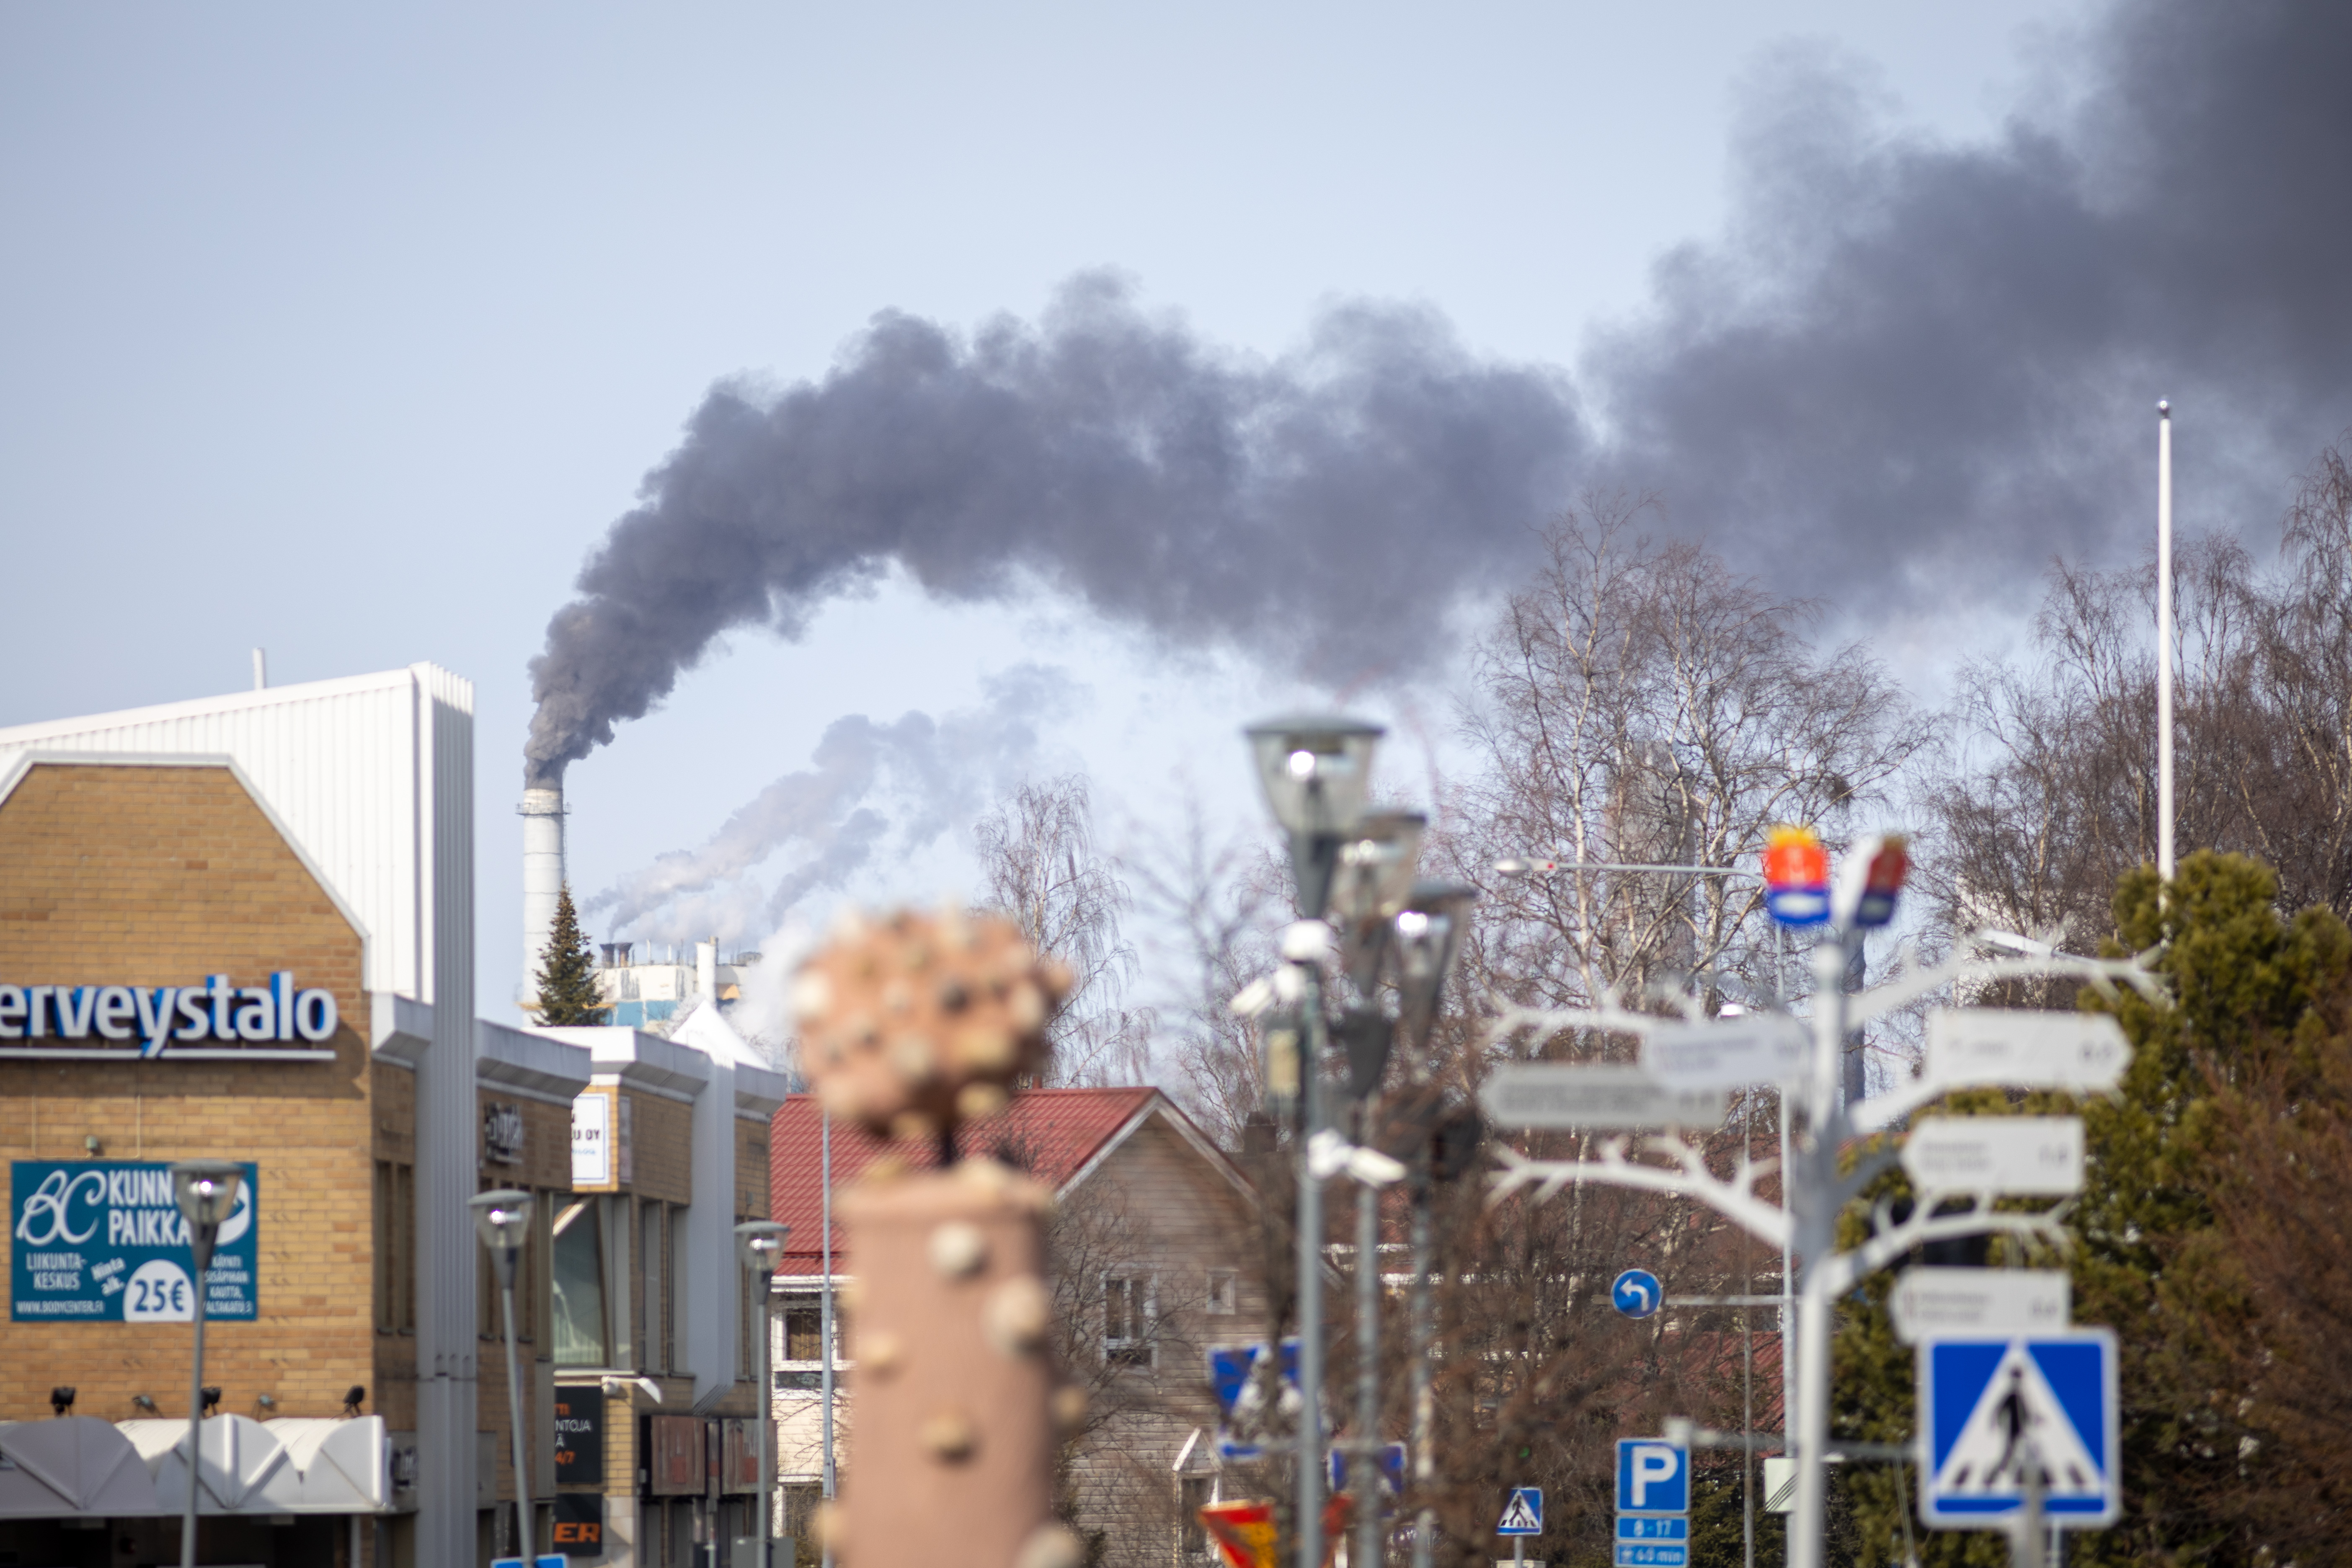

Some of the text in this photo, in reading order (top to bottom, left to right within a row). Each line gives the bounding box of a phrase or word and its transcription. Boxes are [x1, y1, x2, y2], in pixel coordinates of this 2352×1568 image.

[0, 971, 337, 1059] erveystalo
[586, 1129, 599, 1140] OY
[108, 1169, 178, 1207] KUNN
[108, 1209, 194, 1247] PAIKKA
[26, 1252, 87, 1271] LIIKUNTA-
[90, 1257, 126, 1282] Hinta
[34, 1271, 81, 1291] KESKUS
[101, 1275, 125, 1297] alk.
[134, 1279, 184, 1312] 25€
[555, 1419, 592, 1433] NTOJA
[1631, 1445, 1678, 1507] P
[553, 1522, 600, 1543] ER
